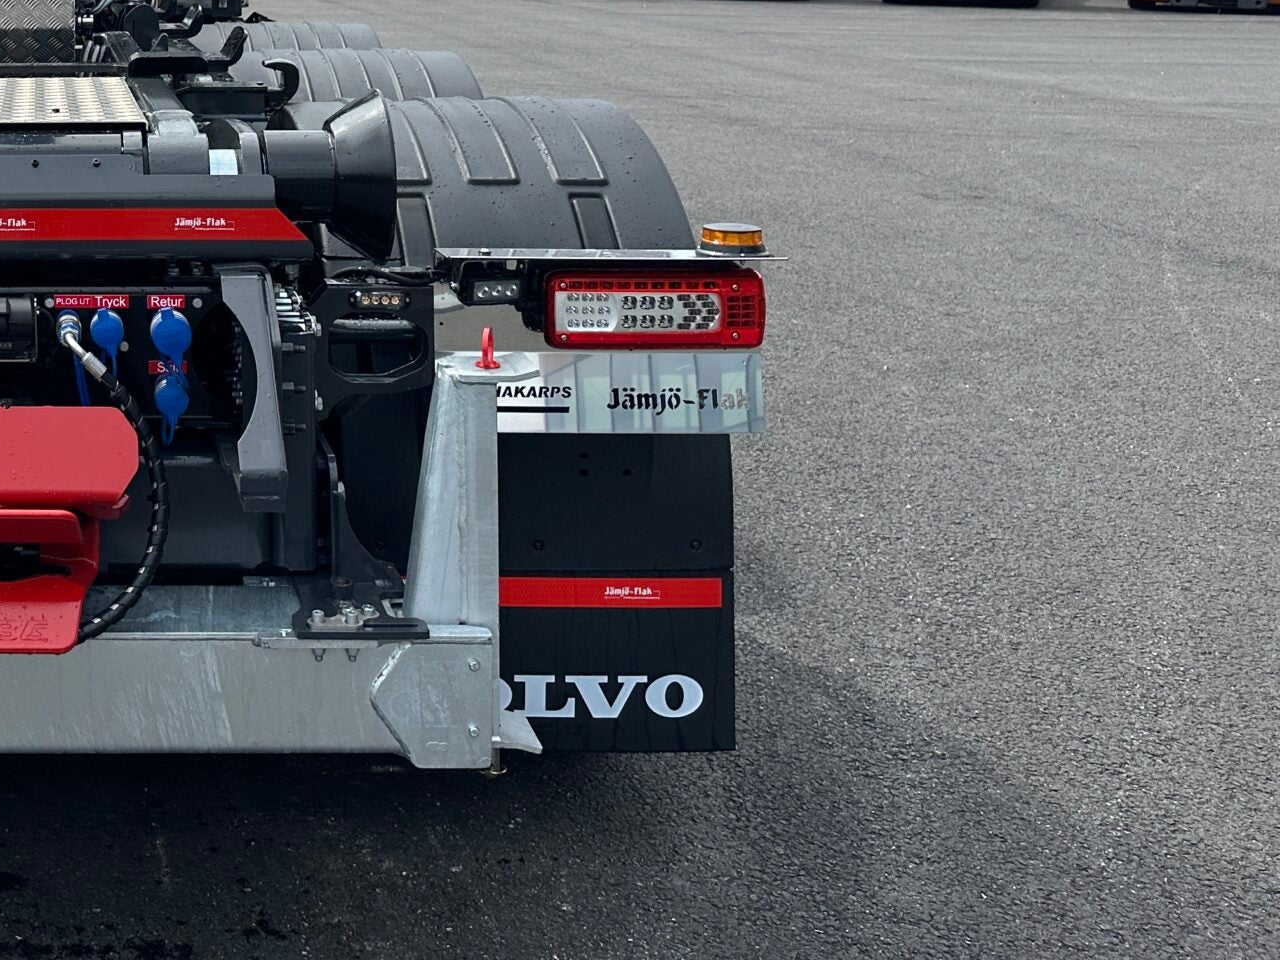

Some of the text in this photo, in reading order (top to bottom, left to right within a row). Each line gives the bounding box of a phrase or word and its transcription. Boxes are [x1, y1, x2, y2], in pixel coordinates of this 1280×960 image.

[174, 217, 226, 228] Jämjö-Flak
[55, 297, 90, 305] PLOG UT
[95, 295, 126, 308] Tryck
[150, 296, 182, 307] Retur
[606, 387, 750, 416] Jämjö-Flak
[604, 587, 652, 597] Jämjö-Flak
[499, 674, 704, 719] LVO
